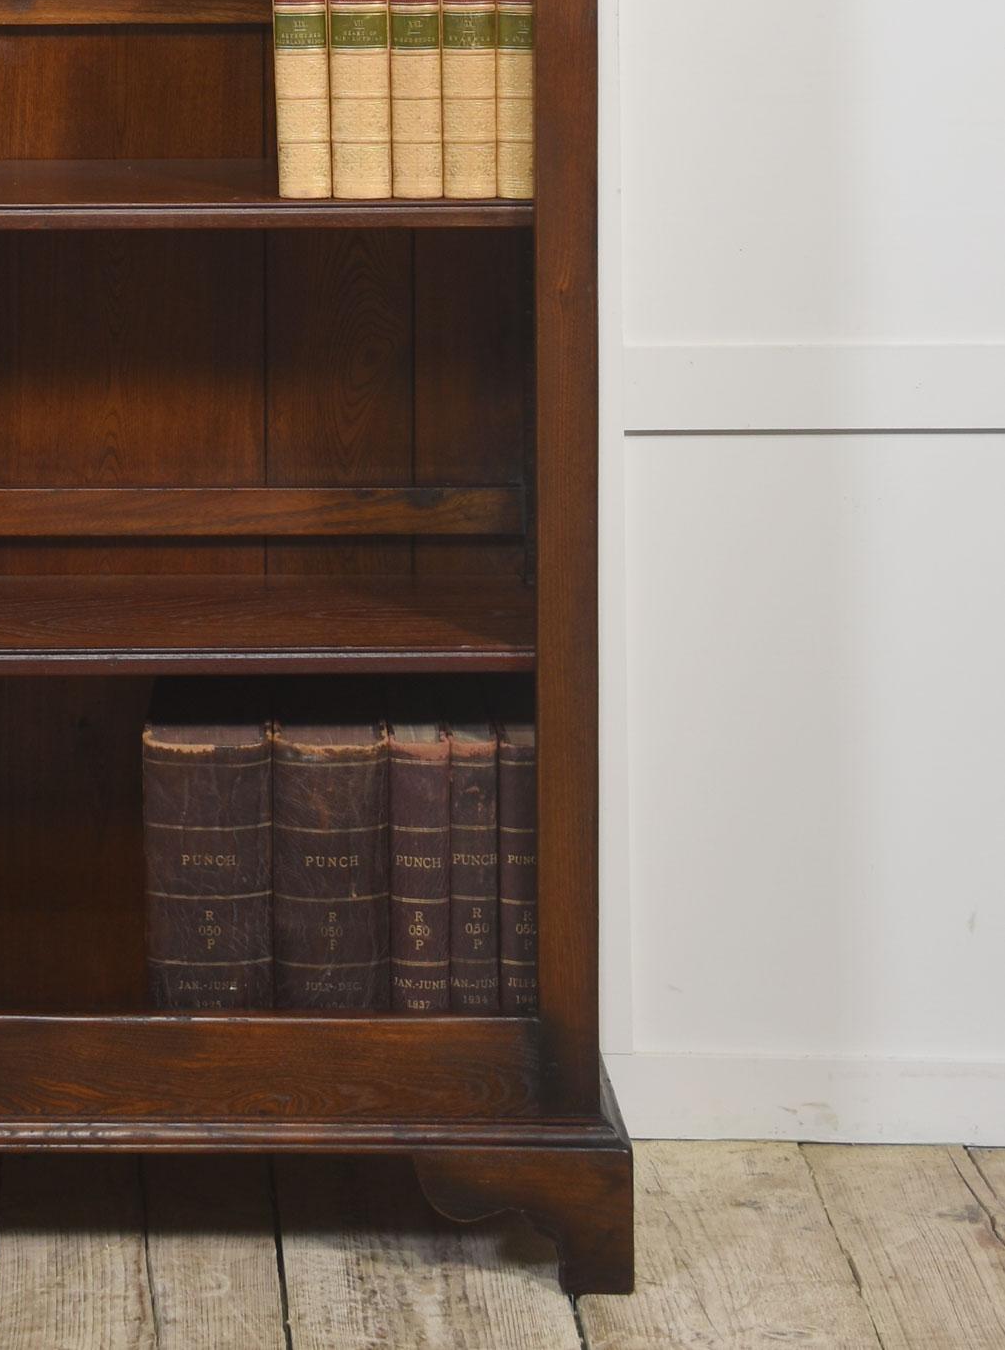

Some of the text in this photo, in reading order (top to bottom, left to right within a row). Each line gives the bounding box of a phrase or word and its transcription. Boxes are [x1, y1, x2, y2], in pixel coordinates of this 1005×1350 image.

[181, 853, 237, 867] PUNCH
[305, 854, 360, 868] PUNCH
[395, 854, 442, 869] PUNCH
[452, 852, 498, 866] PUNCH
[507, 853, 536, 865] PUNC
[205, 910, 214, 921] R
[328, 911, 337, 923] R
[414, 910, 424, 922] R
[472, 907, 482, 919] R
[523, 910, 533, 922] R
[198, 925, 222, 936] 050
[320, 926, 344, 938] 050
[408, 924, 431, 937] 050
[464, 922, 490, 936] 050
[207, 938, 216, 950] P
[414, 939, 425, 951] P
[473, 938, 483, 950] P
[393, 976, 447, 991] JAN.-JUNE
